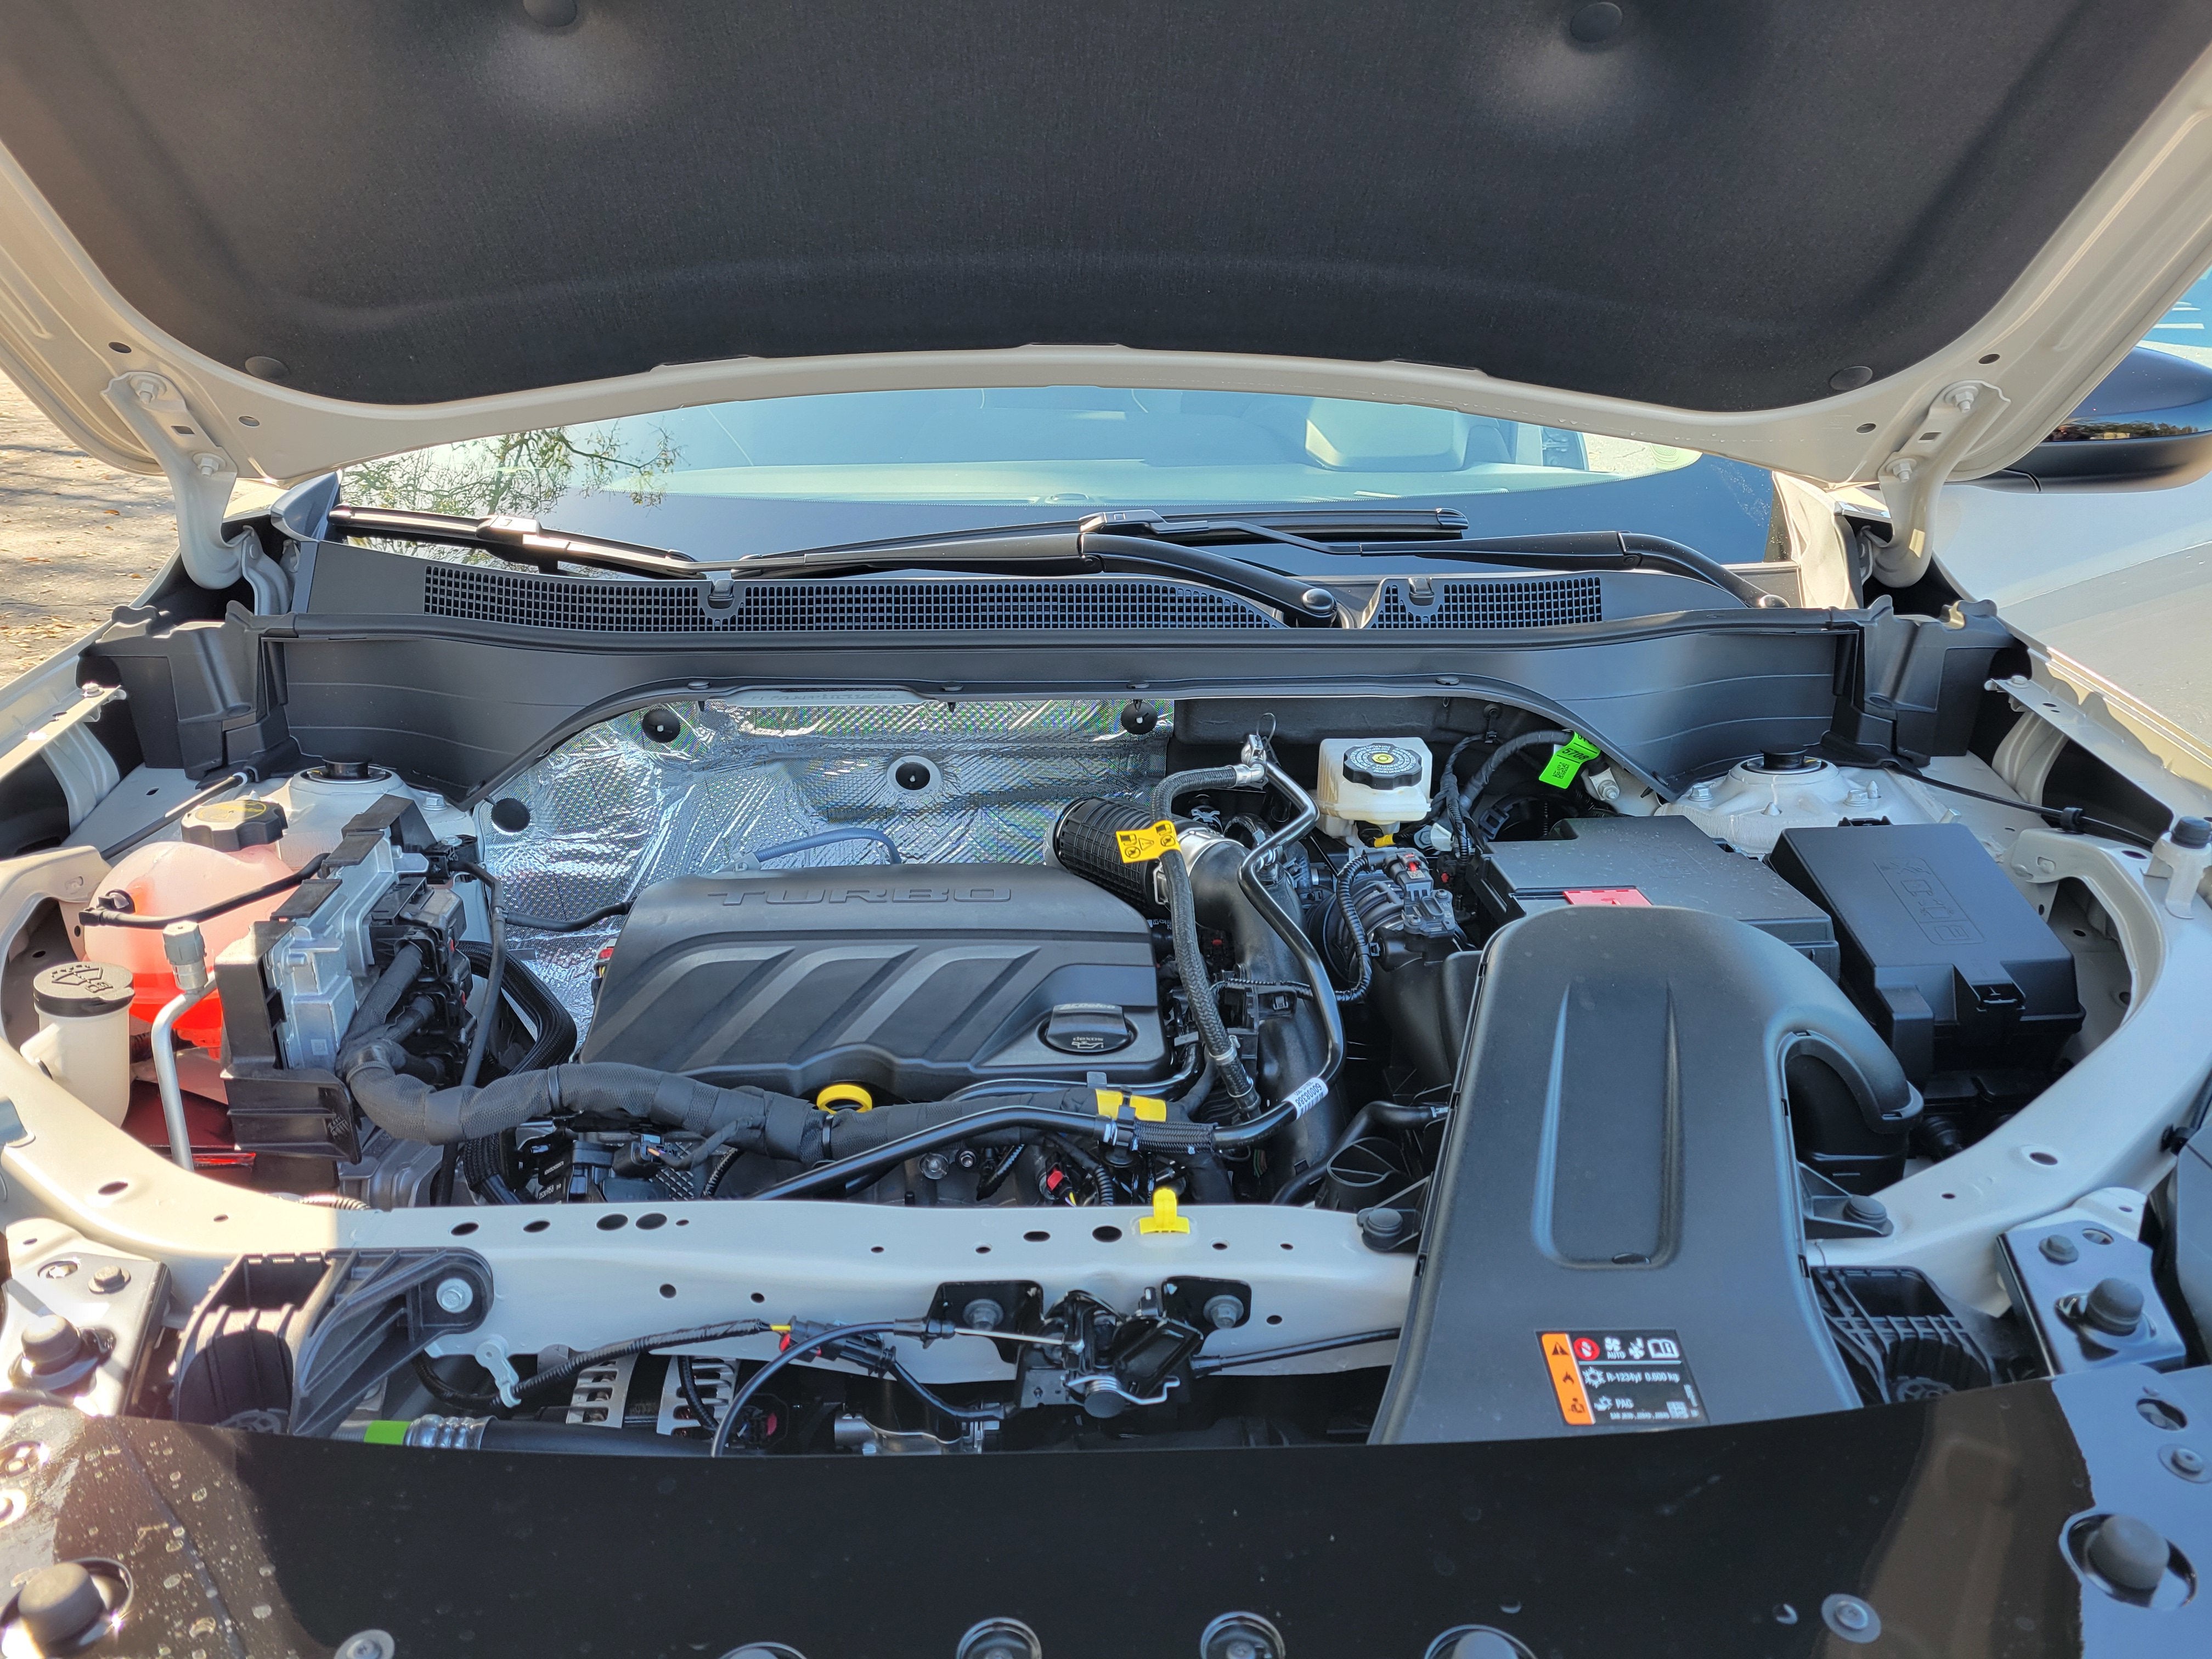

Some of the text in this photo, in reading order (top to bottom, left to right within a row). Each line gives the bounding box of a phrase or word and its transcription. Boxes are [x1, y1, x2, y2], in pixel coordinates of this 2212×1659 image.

[1562, 748, 1589, 760] 5708
[708, 888, 1011, 905] TURBO
[1607, 1351, 1626, 1359] AUTO
[1615, 1398, 1634, 1409] PAG
